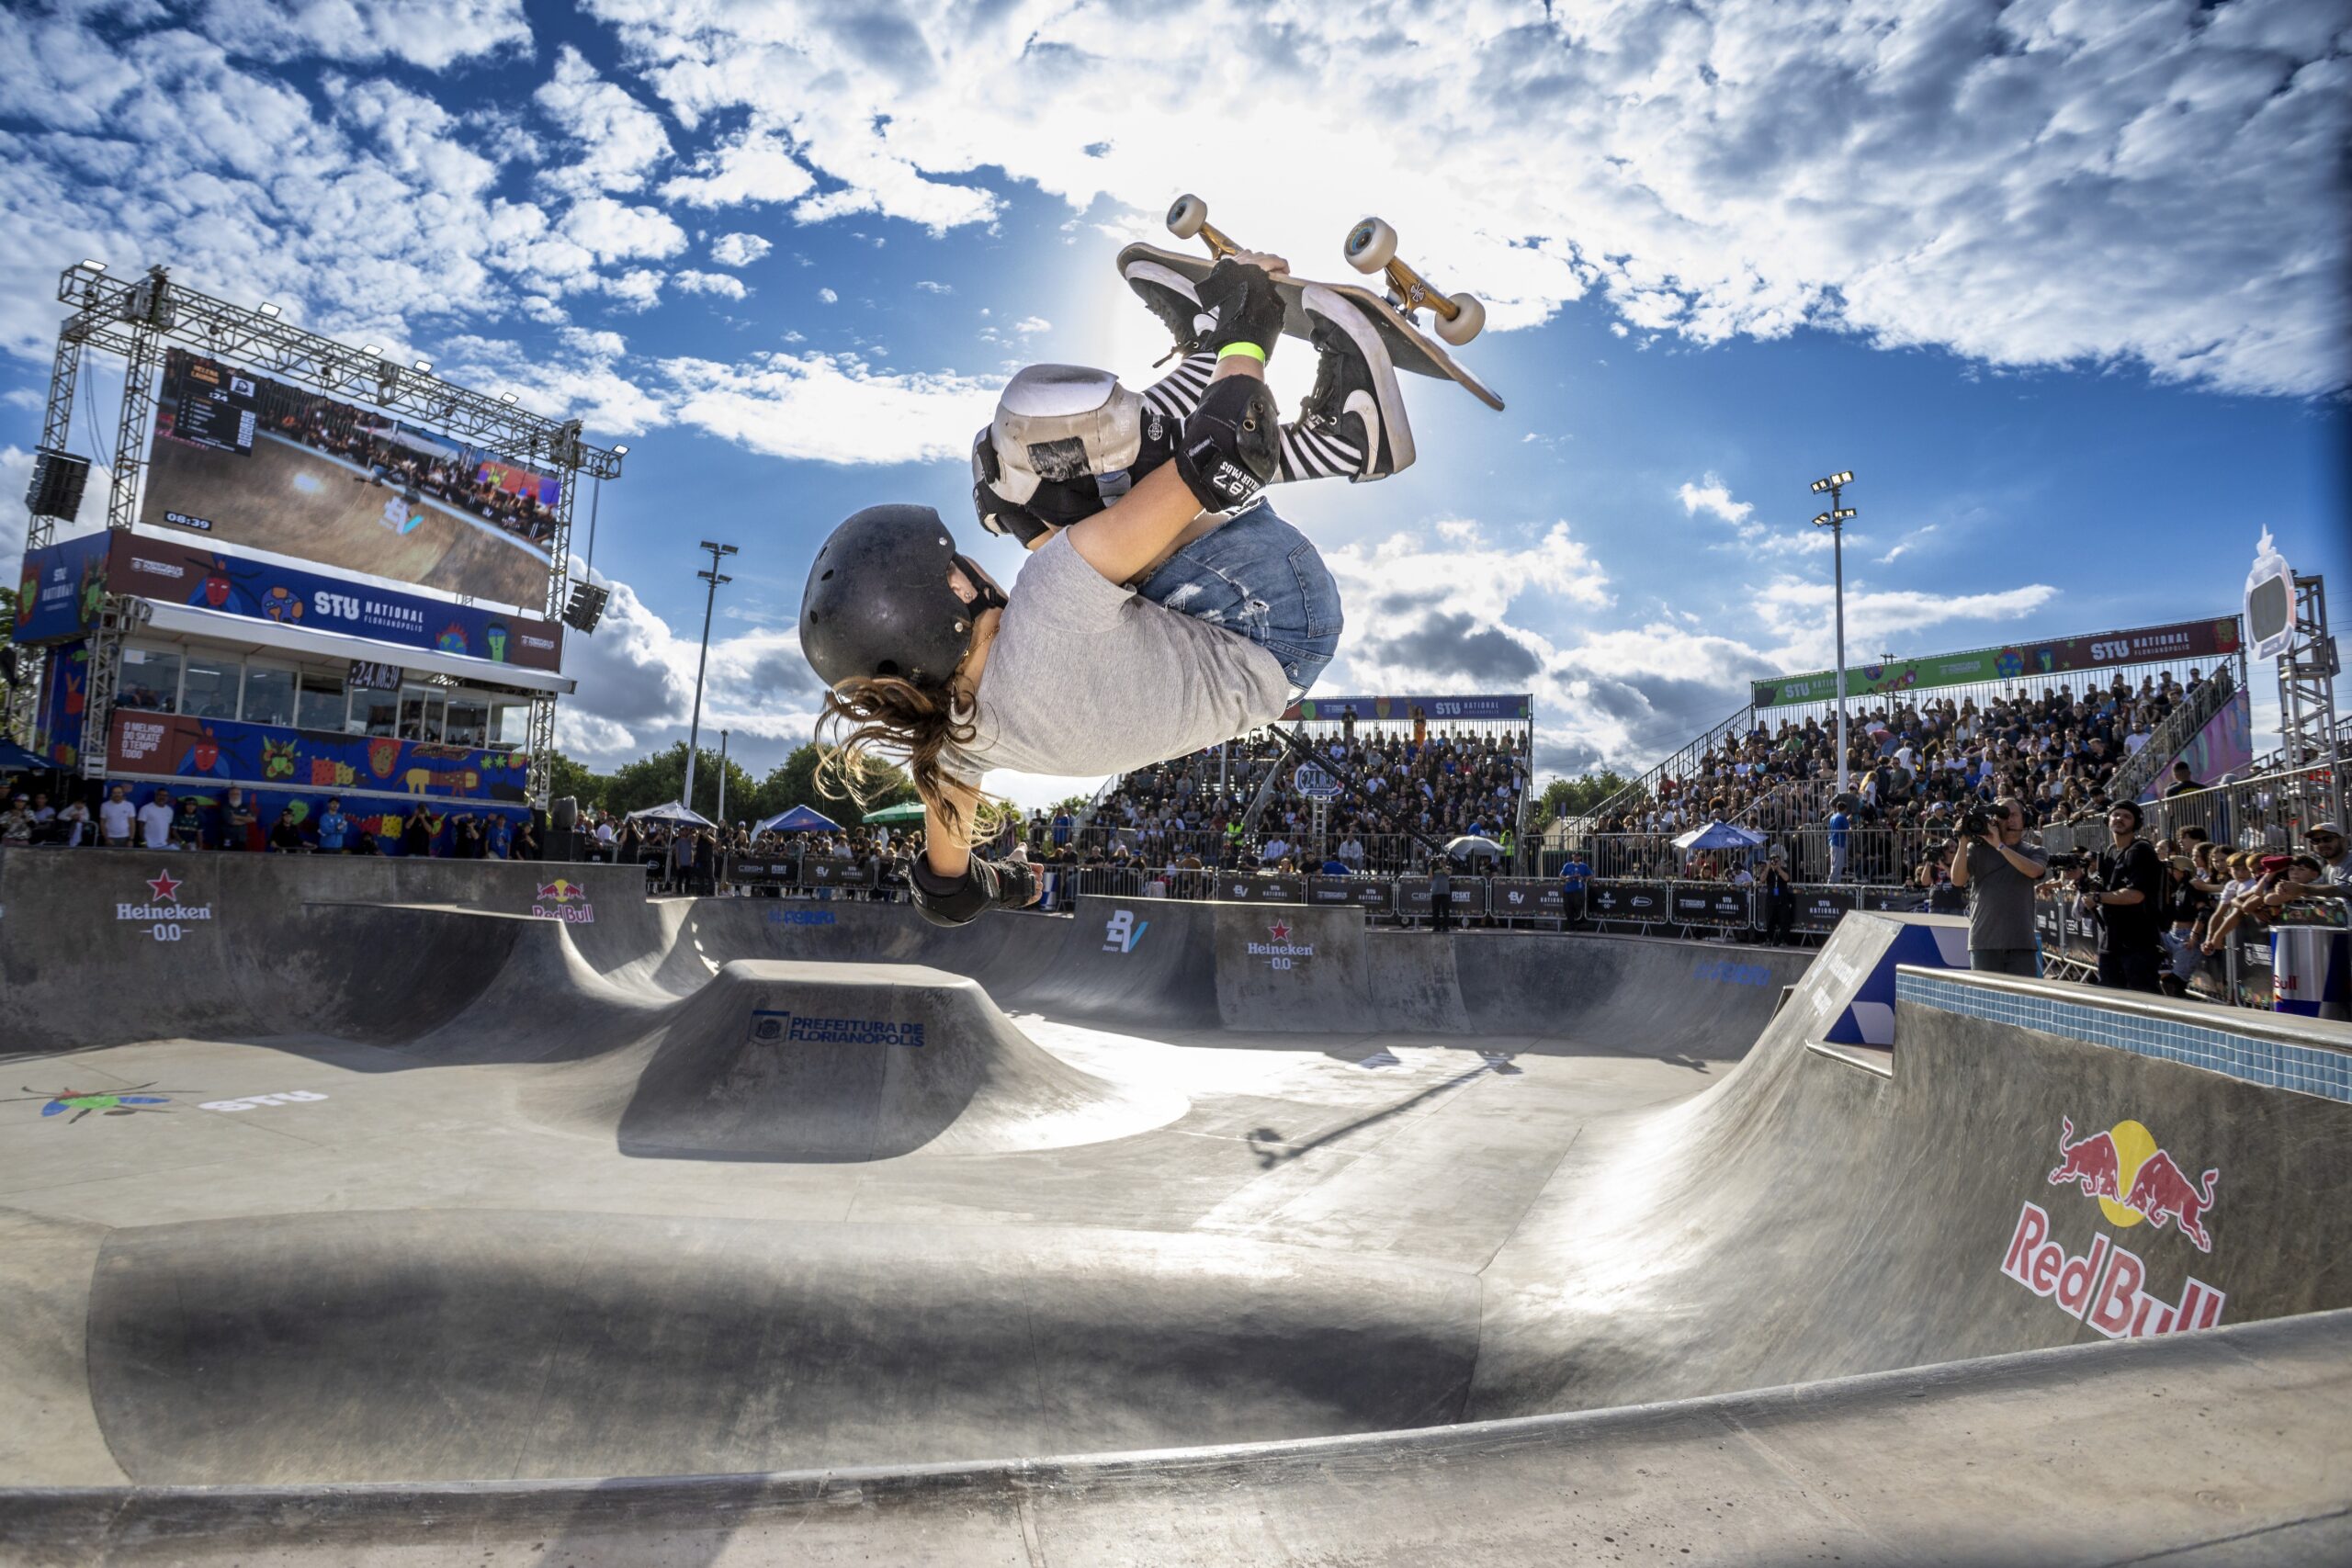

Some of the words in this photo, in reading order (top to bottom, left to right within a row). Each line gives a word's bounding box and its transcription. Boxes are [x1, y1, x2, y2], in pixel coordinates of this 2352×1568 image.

[1220, 461, 1243, 479] PADS
[1213, 474, 1251, 501] 187
[167, 513, 209, 529] 08:39
[314, 591, 360, 620] STU
[365, 601, 424, 623] NATIONAL
[2090, 639, 2131, 660] STU
[2132, 632, 2189, 649] NATIONAL
[1785, 682, 1810, 698] STU
[1435, 702, 1461, 716] STU
[1464, 701, 1499, 710] NATIONAL
[124, 722, 130, 731] O
[131, 722, 164, 734] MELHOR
[123, 731, 134, 740] DO
[135, 732, 162, 743] SKATE
[121, 740, 129, 750] O
[130, 741, 157, 751] TEMPO
[120, 749, 143, 759] TODO
[117, 903, 211, 919] Heineken
[532, 905, 563, 919] Red
[564, 904, 594, 923] Bull
[153, 923, 182, 942] 0.0
[1248, 942, 1314, 956] Heineken
[1272, 957, 1292, 970] 0.0
[791, 1017, 898, 1033] PREFEITURA
[900, 1022, 924, 1035] DE
[789, 1030, 924, 1047] FLORIANÓPOLIS
[198, 1090, 329, 1111] STU
[2001, 1201, 2110, 1320] Red
